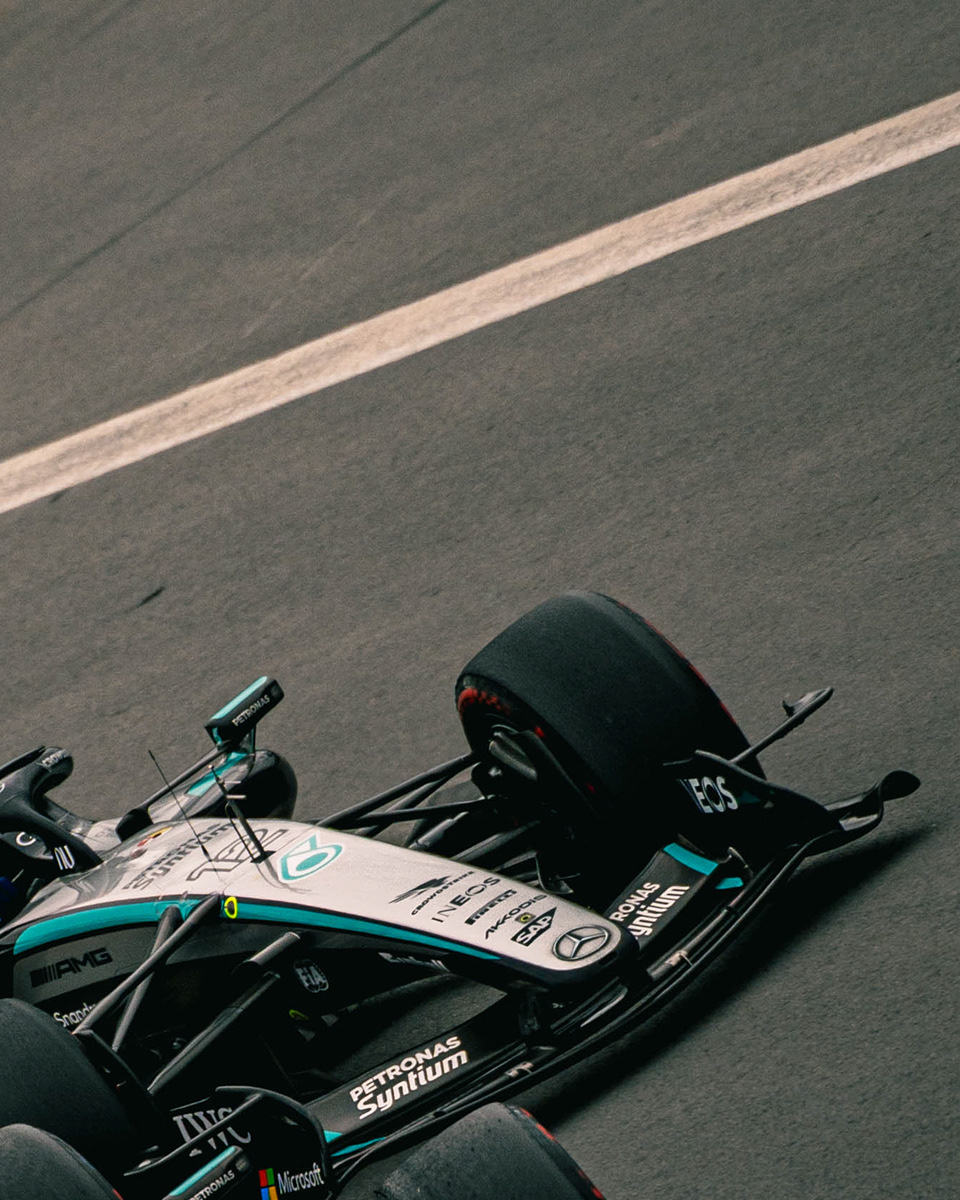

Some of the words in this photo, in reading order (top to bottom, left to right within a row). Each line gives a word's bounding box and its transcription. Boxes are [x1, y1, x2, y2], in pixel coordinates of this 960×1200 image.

[411, 870, 475, 916] CROWDSTRIKE
[431, 876, 501, 923] INEOS
[626, 885, 690, 940] yntium
[515, 914, 553, 945] SAP
[56, 947, 113, 979] AMG
[349, 1036, 461, 1102] PETRONAS
[357, 1050, 468, 1120] Syntium
[172, 1107, 252, 1157] IWC
[277, 1162, 325, 1194] Microsoft
